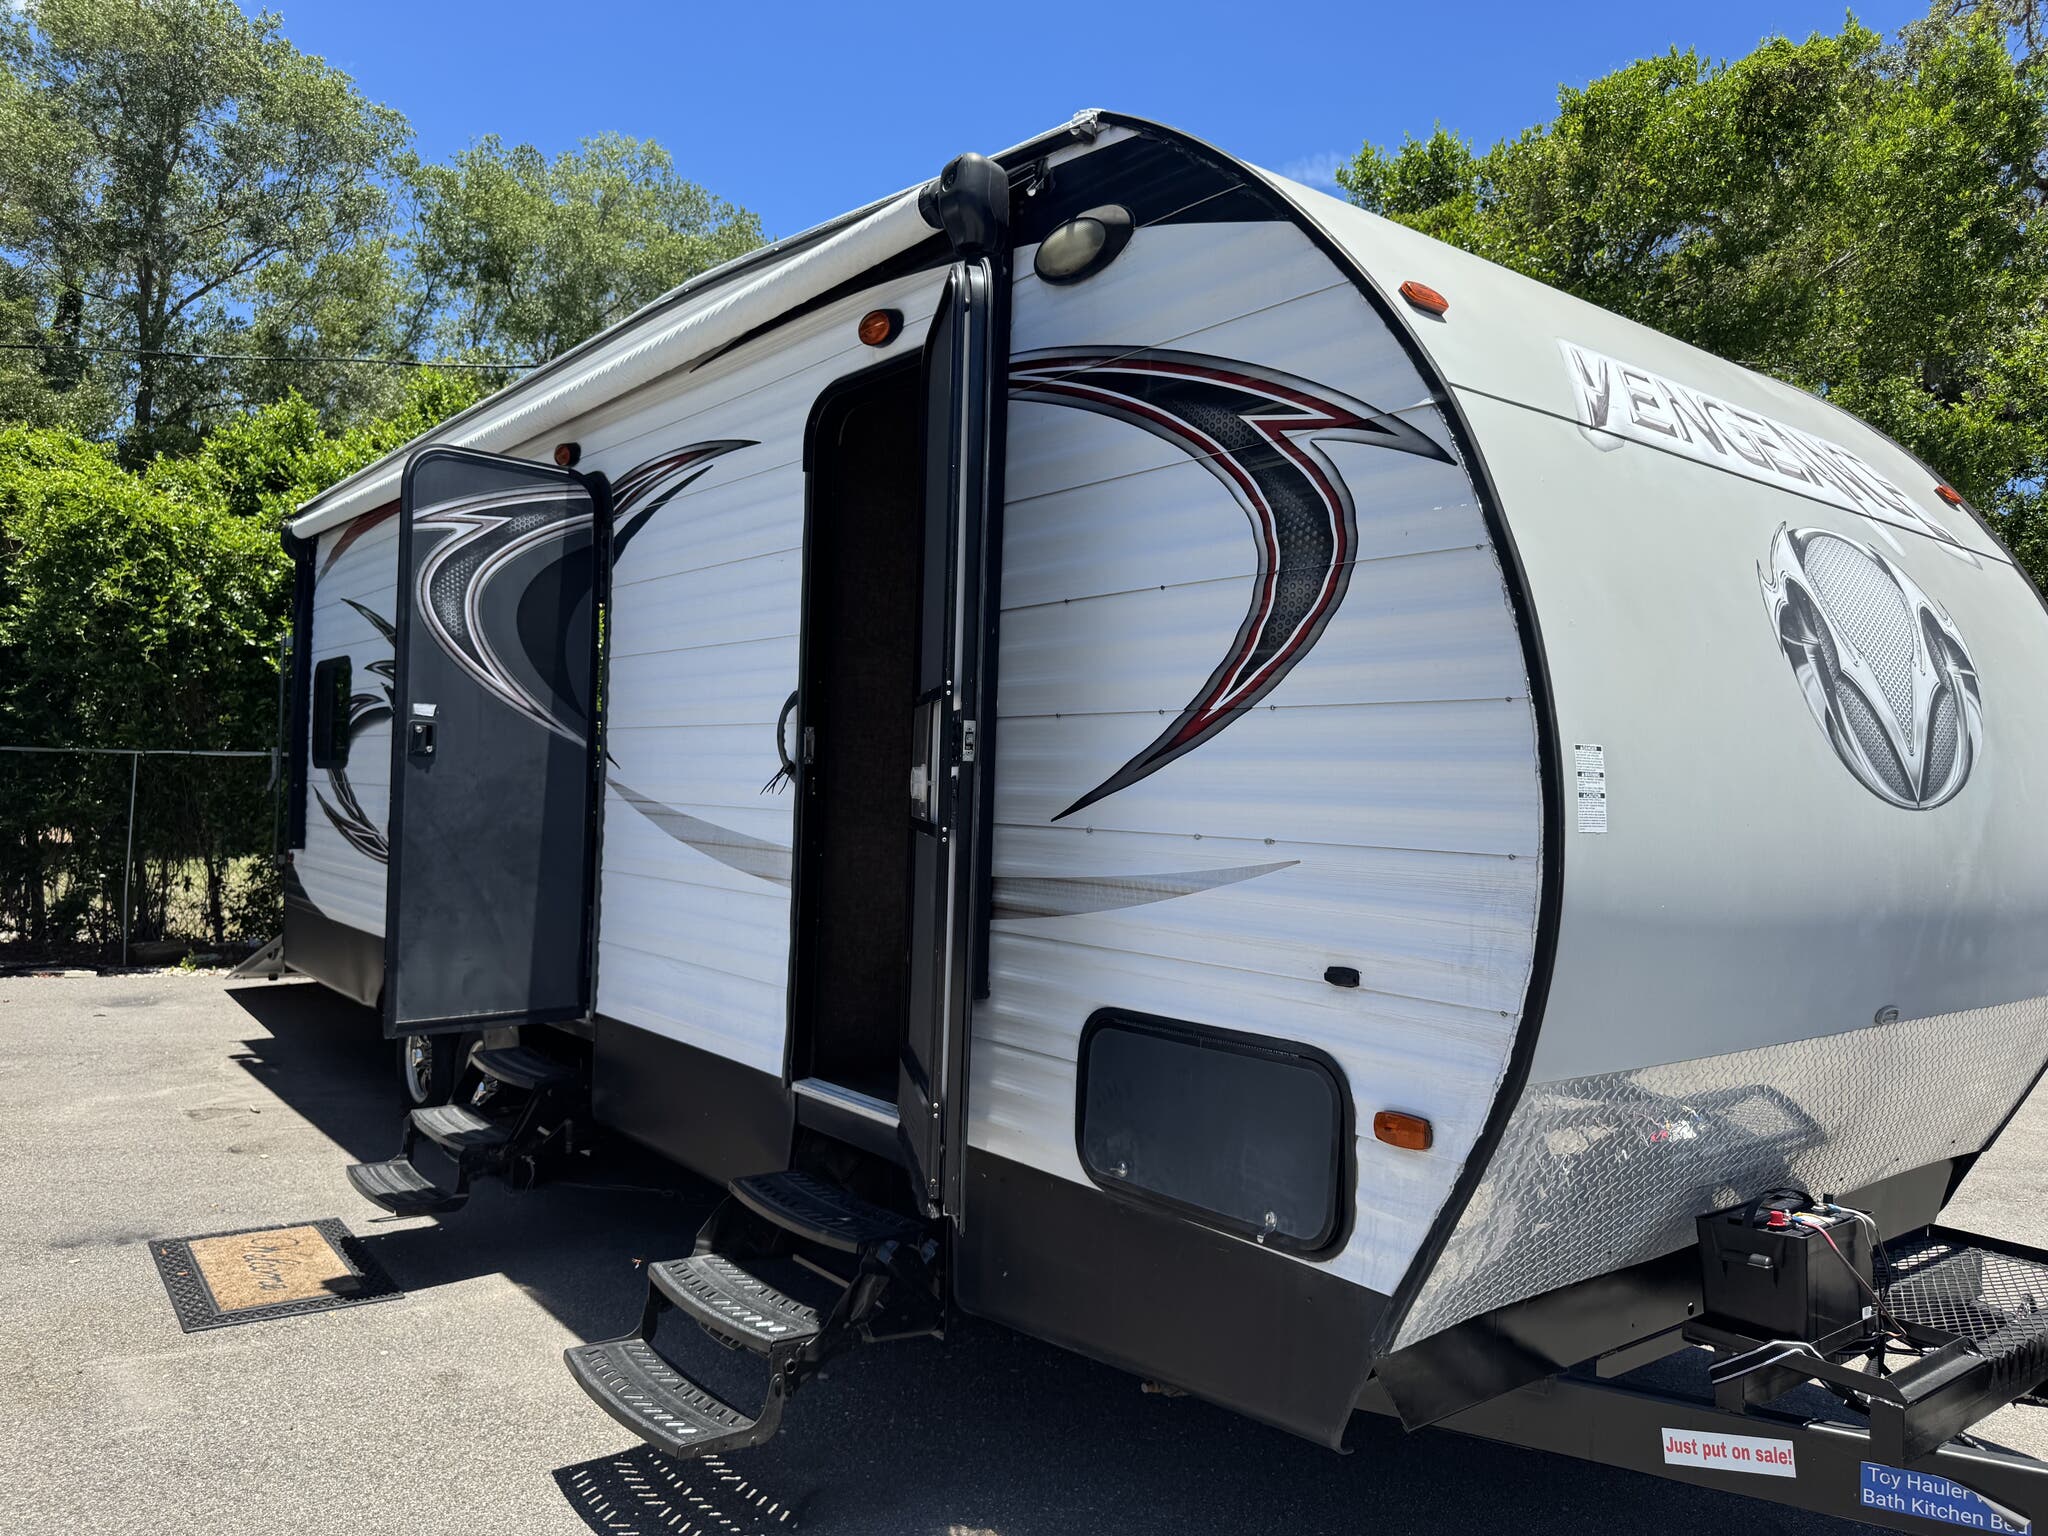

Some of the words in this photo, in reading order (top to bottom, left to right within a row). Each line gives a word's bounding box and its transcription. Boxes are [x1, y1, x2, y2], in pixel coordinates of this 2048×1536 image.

[1568, 346, 1960, 546] VENGEANCE
[1665, 1436, 1698, 1455] Just
[1702, 1441, 1727, 1460] put
[1731, 1446, 1750, 1460] on
[1755, 1446, 1793, 1465] sale!
[1867, 1466, 1901, 1489] Toy
[1907, 1474, 1970, 1500] Hauler
[1863, 1488, 1905, 1511] Bath
[1911, 1499, 1984, 1526] Kitchen
